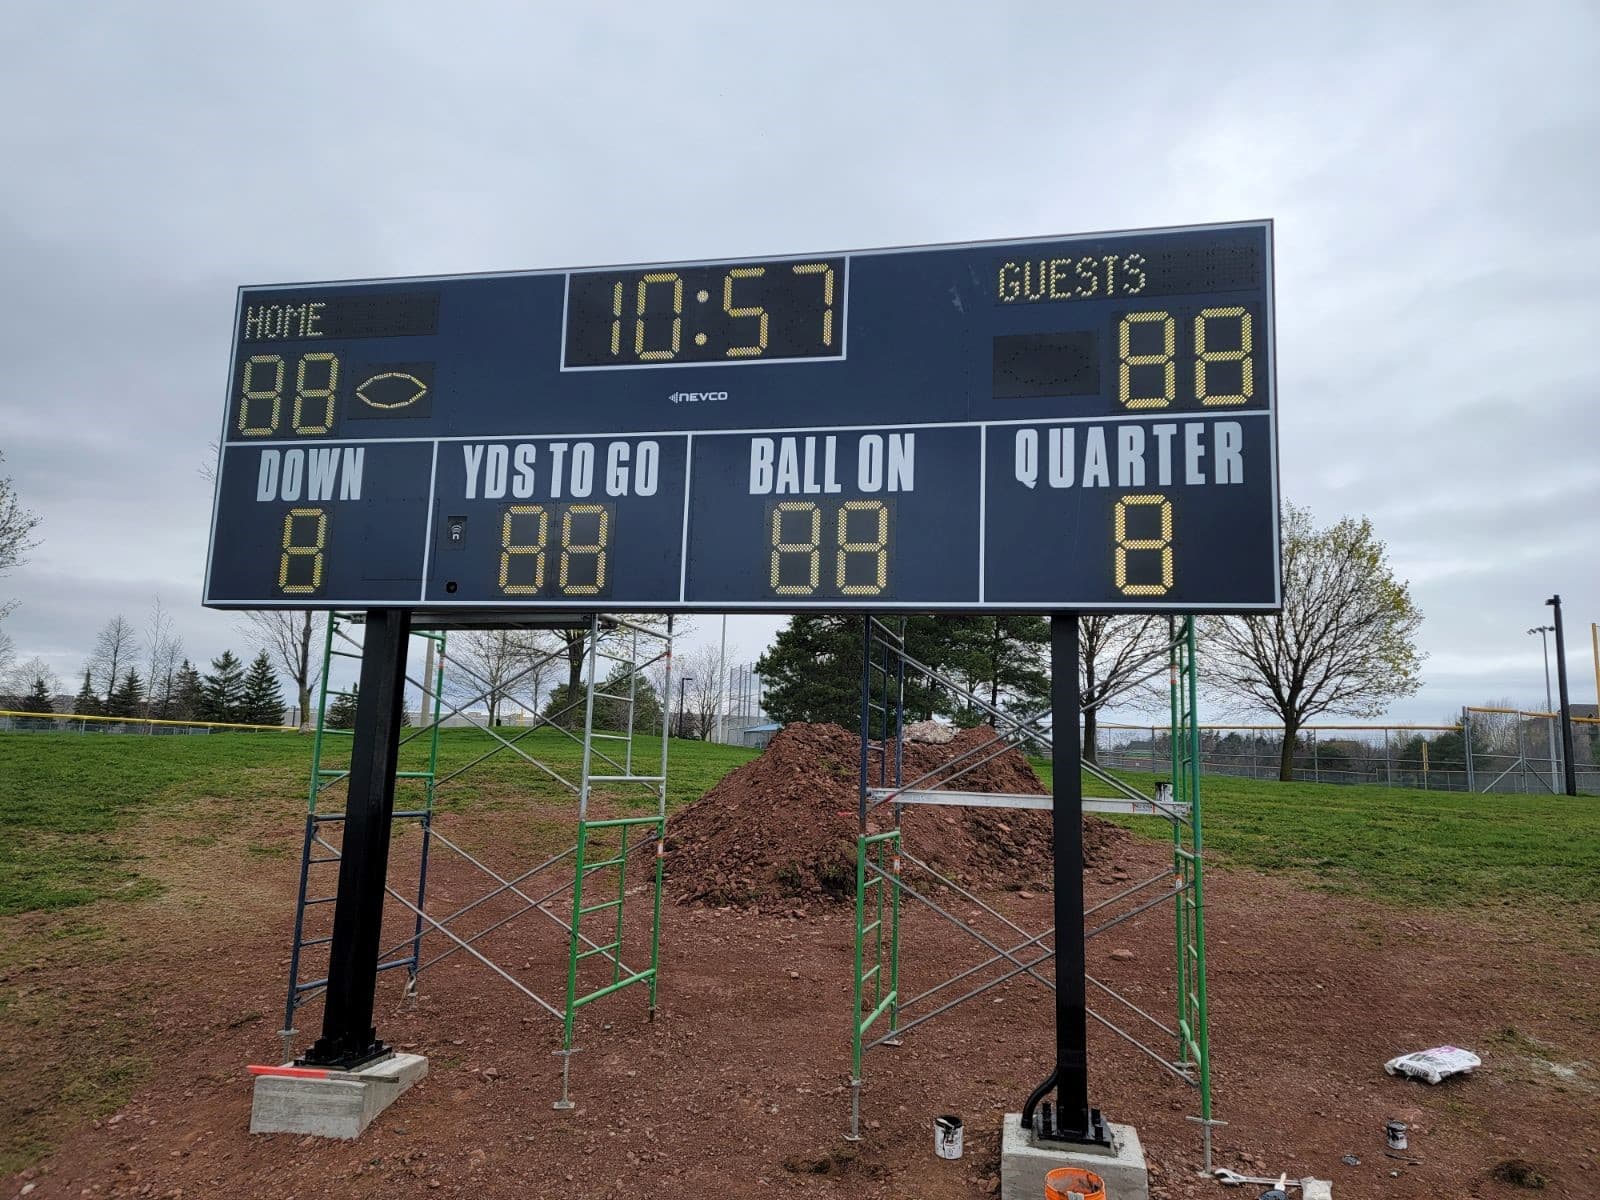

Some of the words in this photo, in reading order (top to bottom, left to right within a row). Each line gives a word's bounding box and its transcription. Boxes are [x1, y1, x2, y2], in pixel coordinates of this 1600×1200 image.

[611, 264, 834, 360] 10:57
[999, 253, 1146, 302] GUESTS
[245, 302, 326, 339] HOME
[1119, 306, 1253, 409] 88
[238, 352, 340, 436] 88
[679, 391, 728, 402] NEVCO
[256, 447, 365, 502] DOWN
[463, 443, 536, 500] YDS
[549, 442, 595, 498] TO
[605, 440, 660, 497] GO
[749, 435, 842, 495] BALL
[857, 433, 915, 493] ON
[1015, 421, 1244, 489] QUARTER
[278, 507, 328, 594] 8
[499, 504, 609, 595] 88
[770, 500, 888, 595] 88
[1115, 494, 1173, 596] 8
